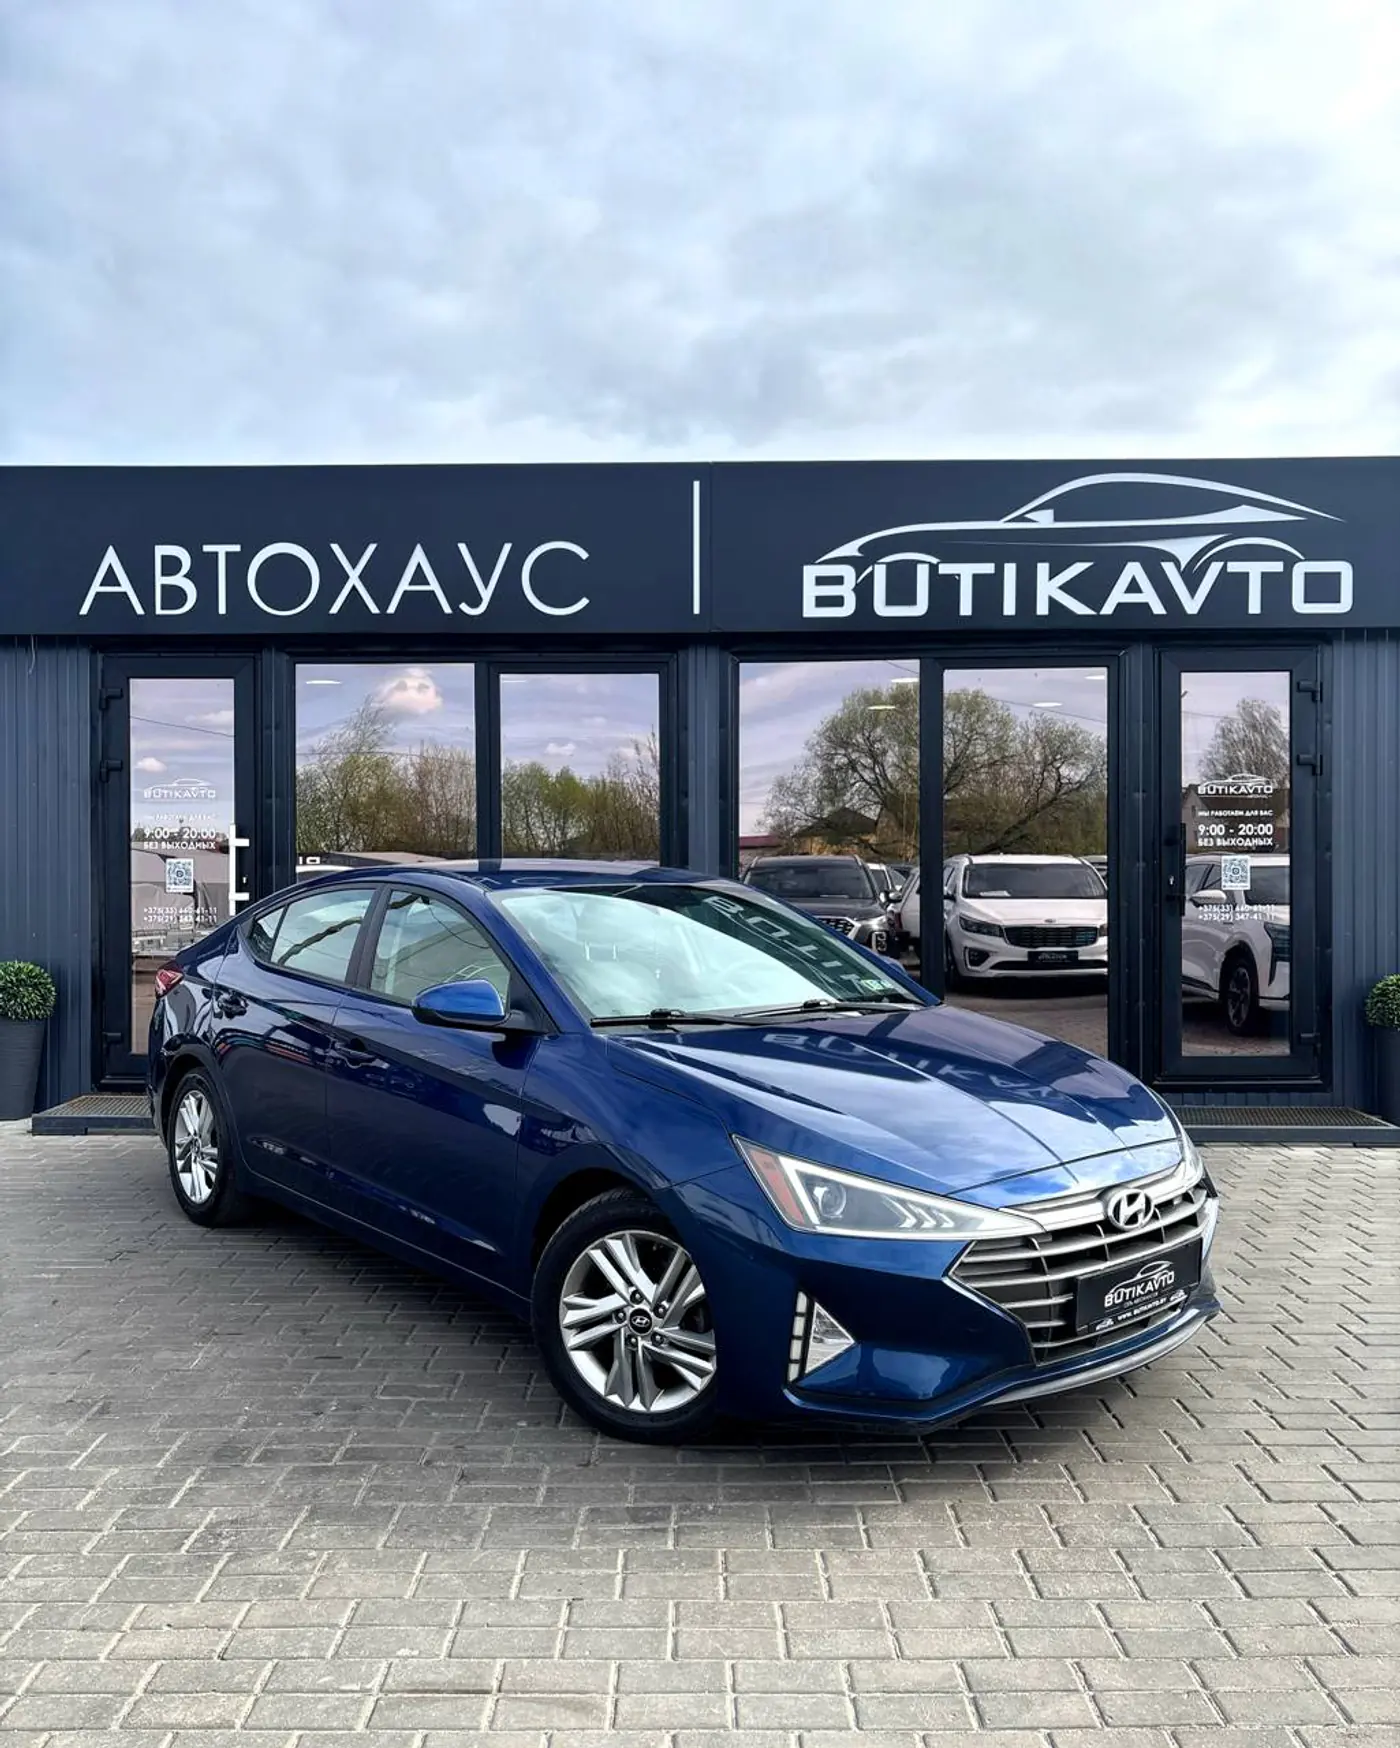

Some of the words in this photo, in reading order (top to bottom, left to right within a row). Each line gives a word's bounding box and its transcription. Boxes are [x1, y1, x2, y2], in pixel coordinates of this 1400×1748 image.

[79, 540, 590, 616] АВТОХАУС
[802, 560, 1354, 617] BUTIKAVTO
[1197, 785, 1273, 795] BUTIKAVTO
[144, 827, 170, 839] 9:00
[182, 827, 216, 839] 20:00
[1198, 823, 1225, 836] 9:00
[1238, 823, 1274, 836] 20:00
[143, 841, 159, 850] БЕЗ
[161, 841, 216, 850] ВЫХОДНЫХ
[1197, 837, 1214, 847] БЕЗ
[1216, 837, 1273, 847] ВЫХОДНЫХ
[1104, 1271, 1175, 1308] BUTIKAVTO
